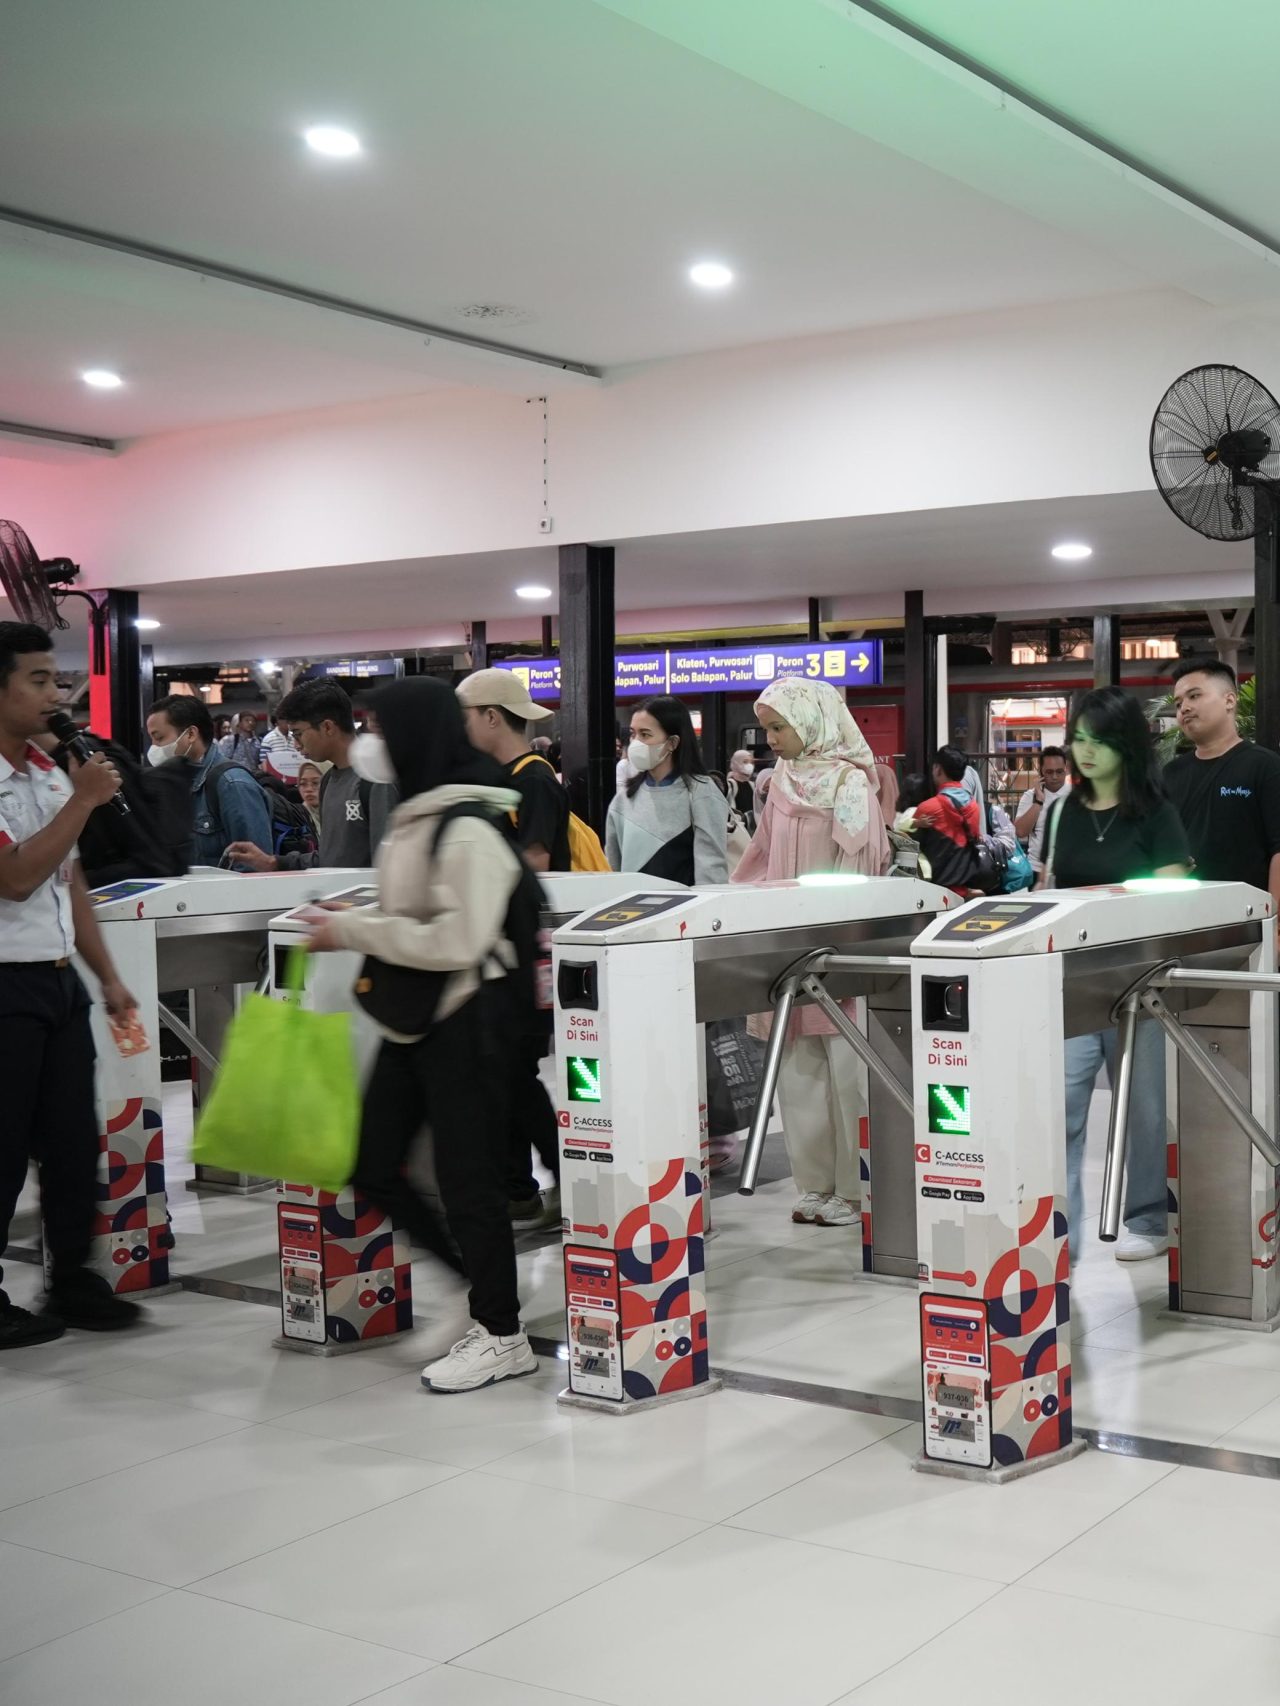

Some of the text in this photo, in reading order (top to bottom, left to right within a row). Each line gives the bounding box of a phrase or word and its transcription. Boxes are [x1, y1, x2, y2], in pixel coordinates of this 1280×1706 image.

[618, 660, 659, 672] Purwosari
[677, 655, 753, 669] Klaten, Purwosari
[777, 653, 821, 677] Peron 3
[530, 668, 553, 679] Peron
[671, 669, 753, 684] Solo Balapan, Palur
[615, 675, 666, 688] lapan, Palur
[570, 1016, 594, 1027] Scan
[567, 1030, 599, 1042] Di Sini
[932, 1037, 962, 1050] Scan
[928, 1053, 968, 1067] Di Sini
[574, 1117, 613, 1128] C-ACCESS
[935, 1151, 984, 1163] C-ACCESS
